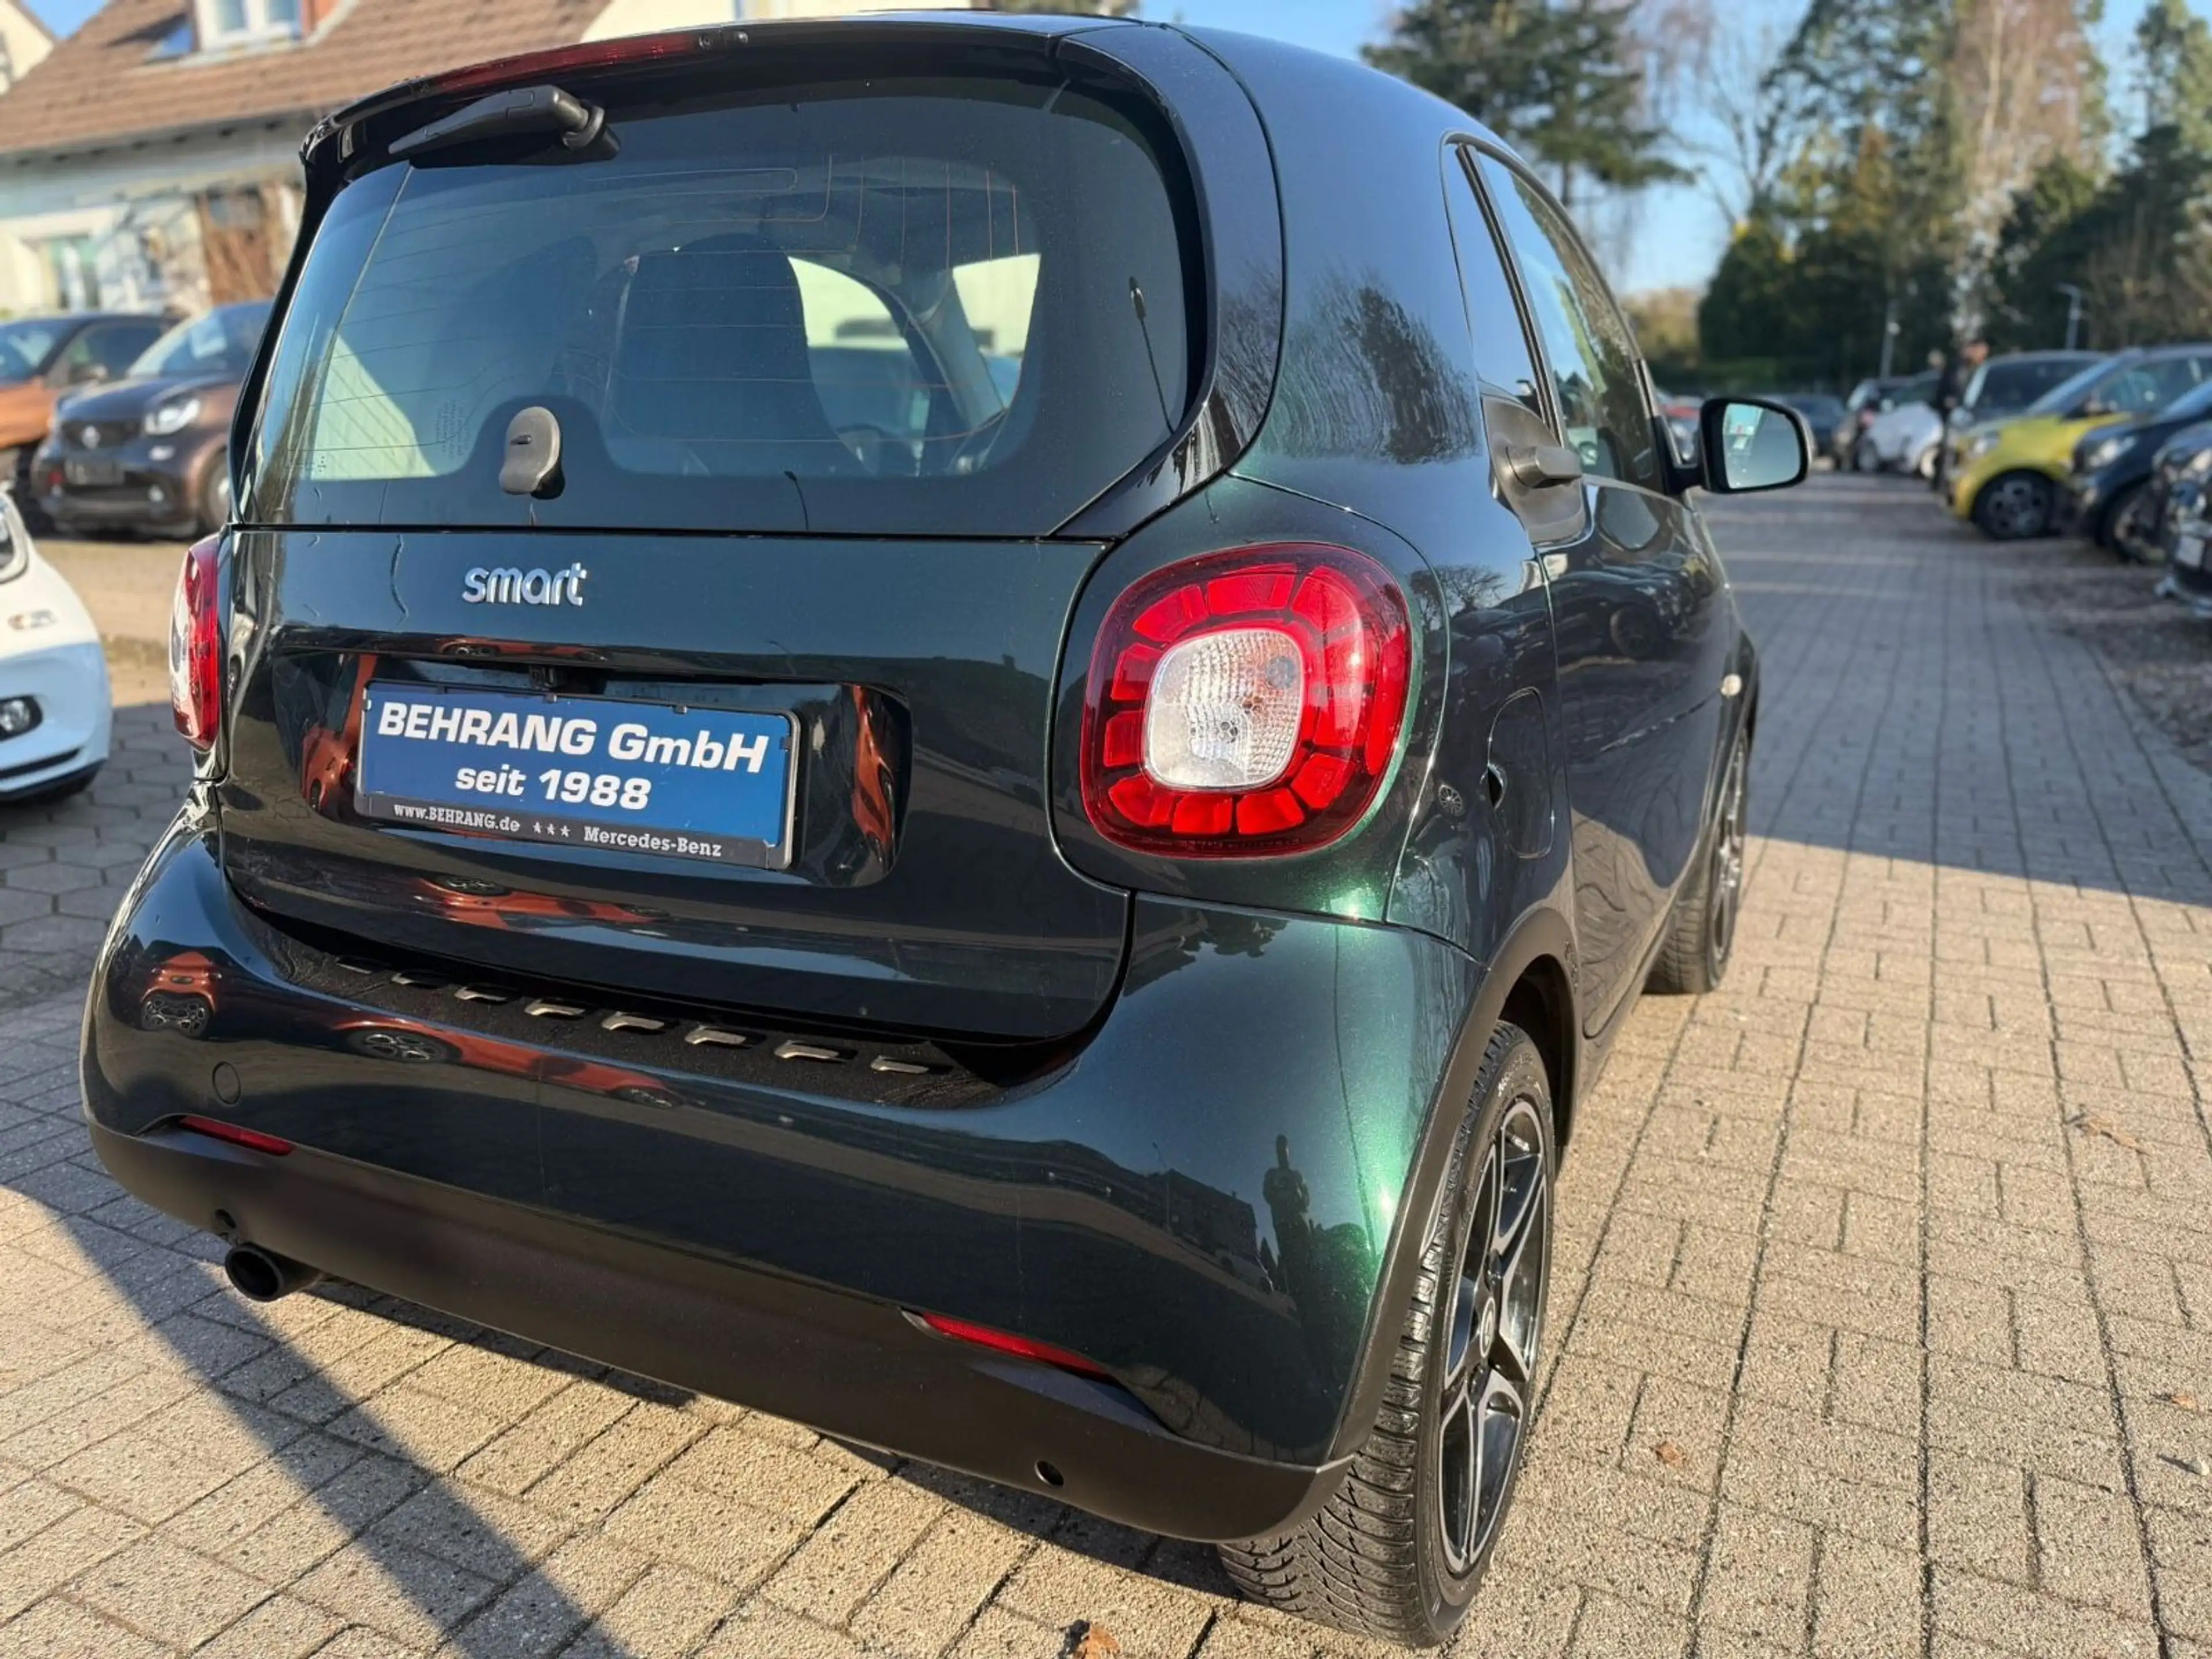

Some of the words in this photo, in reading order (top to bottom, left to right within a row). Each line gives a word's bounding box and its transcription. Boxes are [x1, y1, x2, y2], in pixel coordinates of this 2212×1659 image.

[462, 562, 586, 606] smart
[378, 702, 597, 755] BEHRANG
[608, 723, 770, 773] GmbH
[454, 764, 527, 796] seit
[539, 769, 652, 810] 1988
[393, 804, 520, 832] www.BEHRANG.de
[584, 825, 722, 857] Mercedes-Benz
